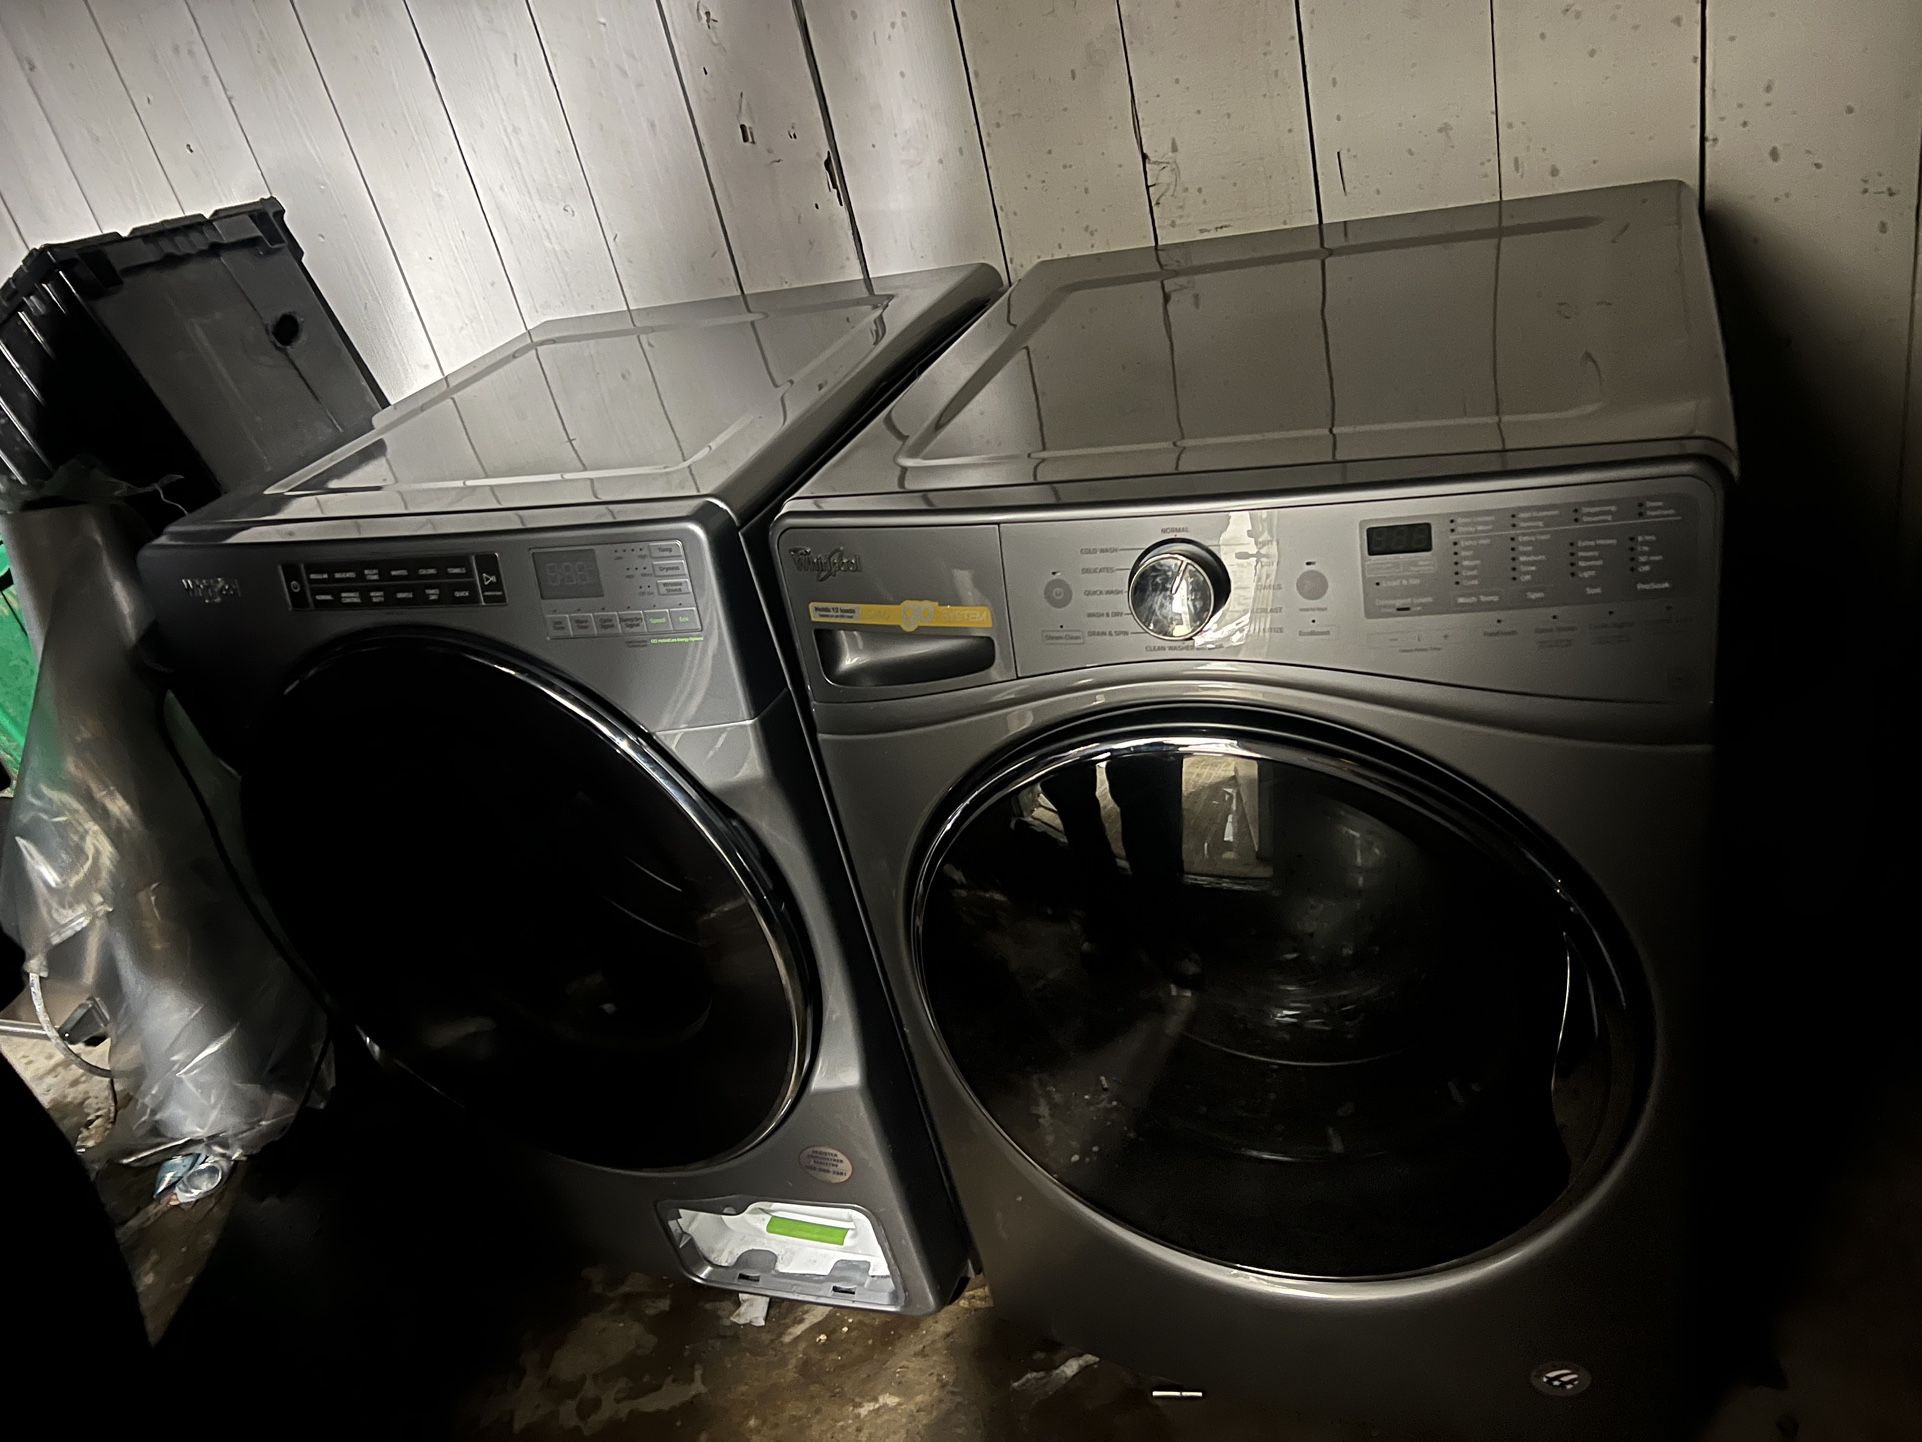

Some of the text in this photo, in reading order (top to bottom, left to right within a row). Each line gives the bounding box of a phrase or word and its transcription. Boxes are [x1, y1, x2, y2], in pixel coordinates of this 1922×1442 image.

[1160, 526, 1189, 535] NORMAL
[1079, 545, 1119, 555] COLD WASH
[788, 546, 864, 583] Whirlpool
[1081, 566, 1115, 575] DELICATES
[1083, 588, 1124, 597] QUICK WASH
[831, 606, 840, 615] 12
[1086, 611, 1105, 619] WASH
[940, 609, 988, 623] SYSTEM
[1087, 630, 1107, 638] DRAIN
[1114, 629, 1130, 637] SPIN
[1144, 645, 1167, 653] CLEAN
[1167, 644, 1195, 653] WASHER
